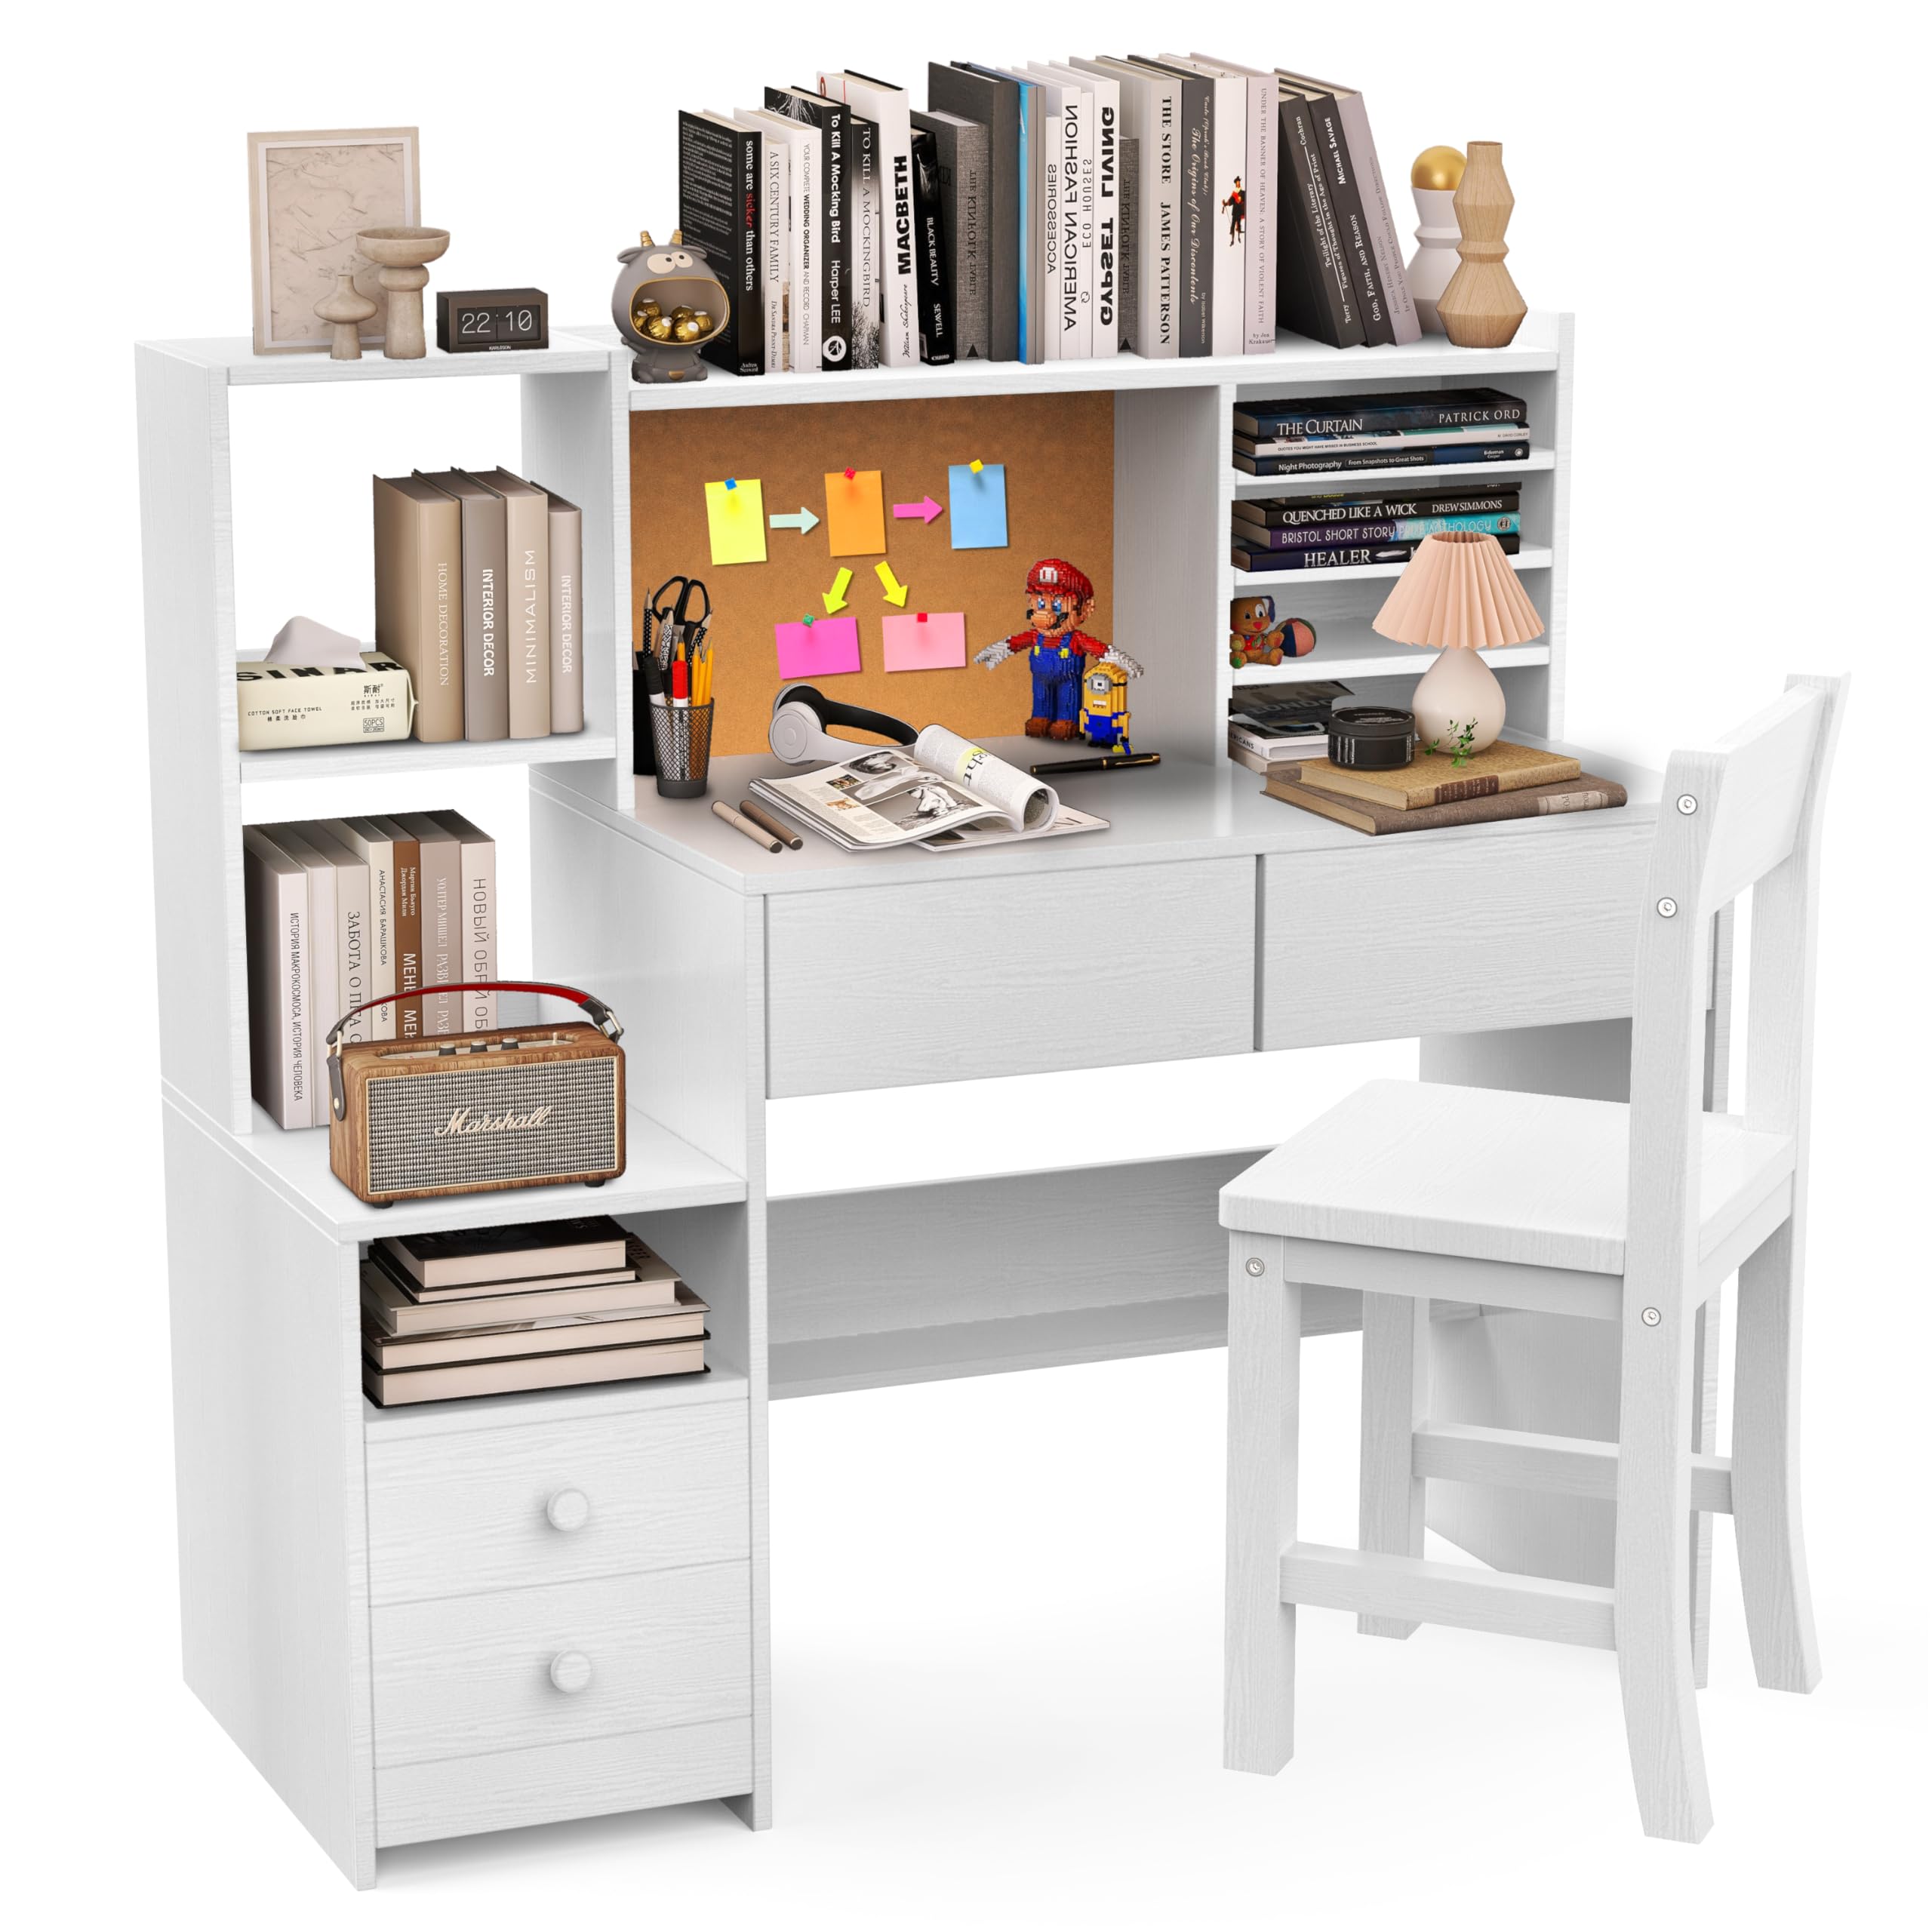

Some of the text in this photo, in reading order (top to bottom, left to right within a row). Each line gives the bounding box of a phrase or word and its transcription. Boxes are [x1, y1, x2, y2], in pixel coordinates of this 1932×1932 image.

[1310, 153, 1319, 173] Print
[1324, 116, 1346, 185] MICHAEL SAVAGE
[770, 161, 779, 180] SIX
[1260, 168, 1266, 178] OF
[1314, 174, 1321, 182] of
[746, 193, 756, 228] sicker
[770, 181, 779, 237] CENTURY
[894, 155, 912, 275] MACBETH
[1307, 183, 1318, 214] Literary
[829, 114, 841, 324] To Kill A Mocking Bird Harper LEE
[863, 128, 871, 307] TO KILL A MOCKINGBIRD
[1160, 96, 1172, 345] THE STORE JAMES PATTERSON
[1187, 127, 1201, 305] The Origins of Our Discontents
[1296, 116, 1352, 324] Terry Cochran
[1317, 227, 1324, 236] of
[1325, 211, 1331, 220] in
[1349, 214, 1364, 249] REASON
[746, 230, 755, 254] than
[1320, 237, 1332, 268] Twilight
[1327, 222, 1339, 254] Thought
[746, 257, 755, 291] others
[770, 239, 779, 283] FAMILY
[1259, 252, 1265, 263] OF
[926, 217, 943, 338] BLACK BEAUTY SEWELL
[1338, 263, 1349, 290] Figures
[1276, 409, 1521, 435] THE CURTAIN PATRICK ORD
[1278, 463, 1298, 473] Night
[1298, 460, 1342, 471] Photography
[1362, 457, 1389, 466] Snapshots
[1282, 508, 1346, 525] QUENCHED
[1349, 506, 1371, 518] LIKE
[1373, 505, 1383, 518] A
[1385, 503, 1417, 515] WICK
[1281, 531, 1321, 544] BRISTOL
[1325, 528, 1359, 541] SHORT
[1362, 526, 1395, 540] STORY
[1303, 549, 1371, 568] HEALER
[438, 562, 450, 687] HOME DECORATION
[482, 568, 495, 677] INTERIOR DECOR
[525, 549, 537, 684] MINIMALISM
[561, 575, 572, 674] INTERIOR DECOR
[364, 718, 383, 727] 50PCS
[408, 867, 417, 892] Мартин
[436, 878, 448, 947] УОЛТЕР МИШЕЛ
[473, 878, 490, 943] НОВЫЙ
[347, 911, 361, 971] ЗАБОТА
[349, 977, 361, 988] О
[290, 912, 303, 1102] ИСТОРИЯ МАКРОКОСМОСА, ИСТОРИЯ ЧЕЛОВЕКА
[435, 1106, 552, 1137] Marshall
